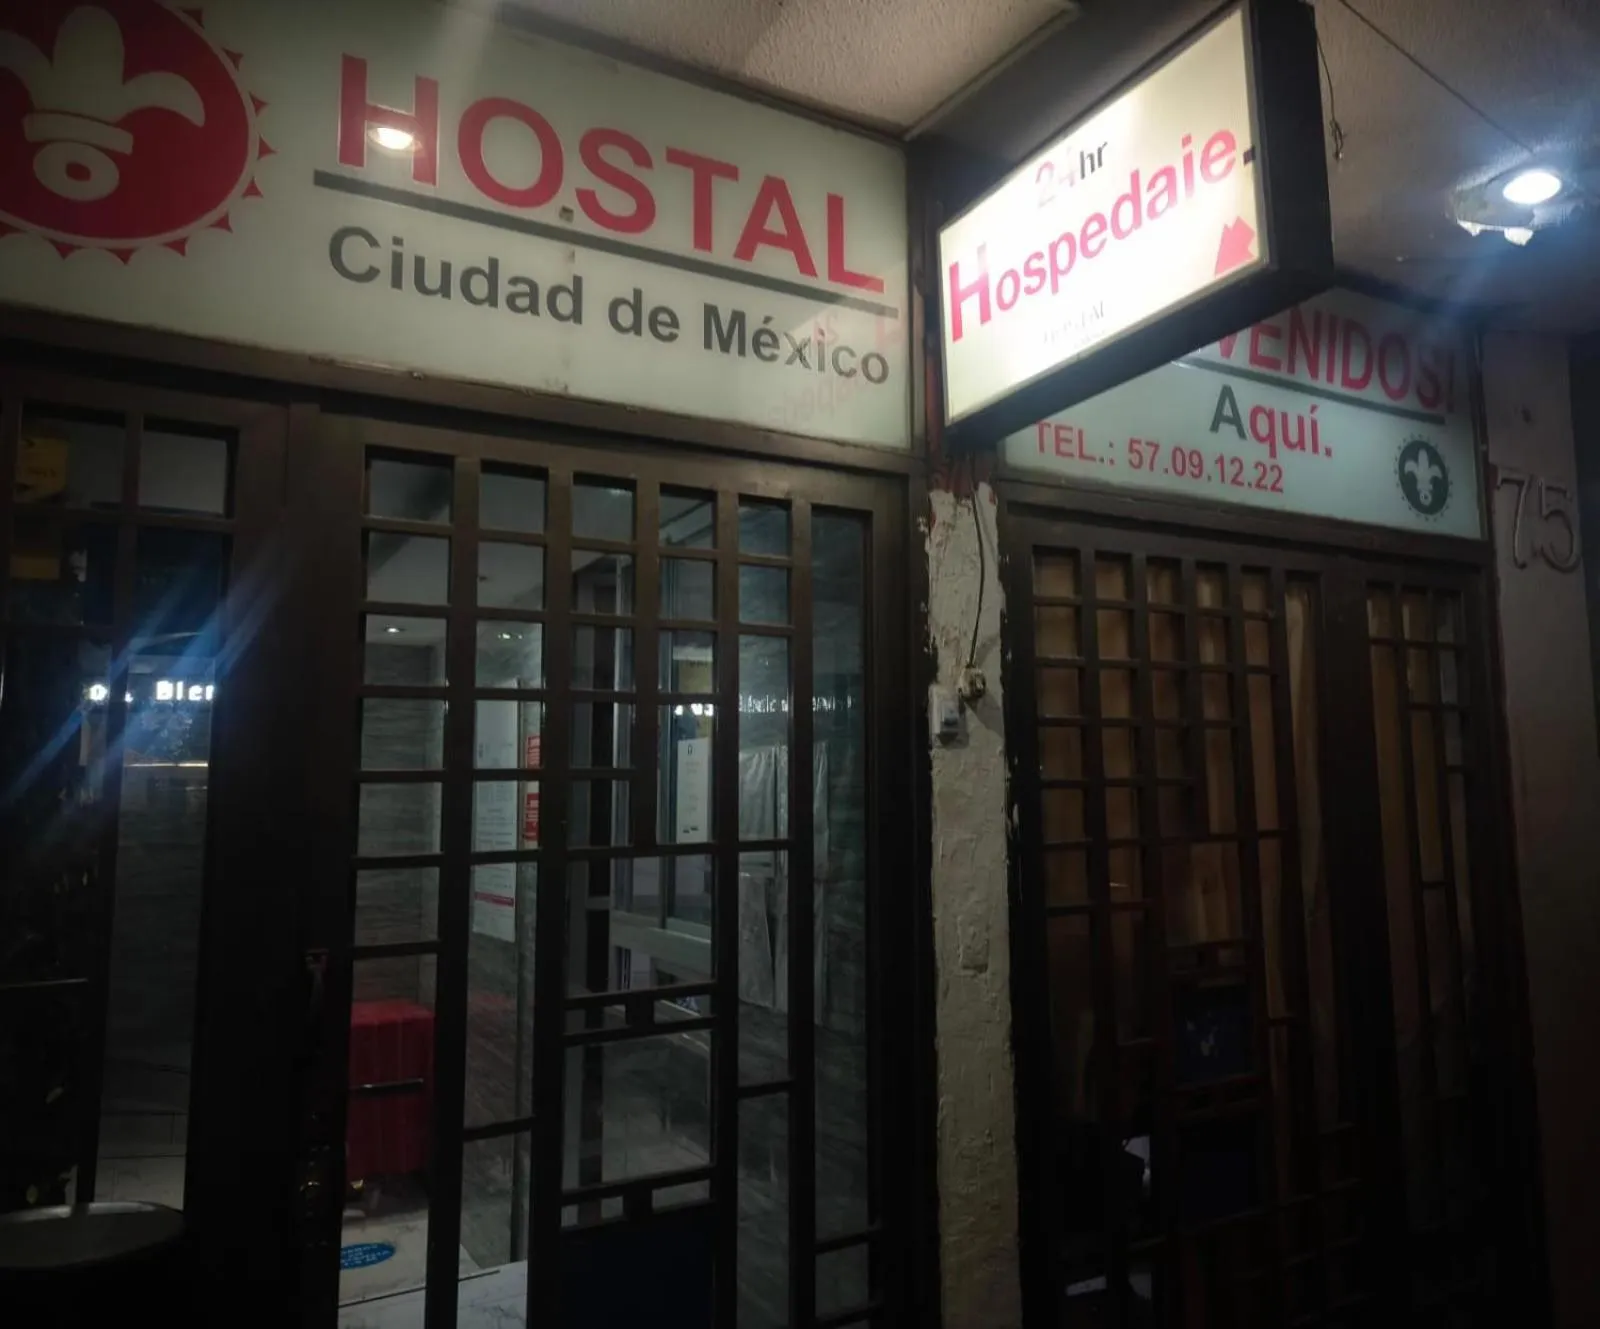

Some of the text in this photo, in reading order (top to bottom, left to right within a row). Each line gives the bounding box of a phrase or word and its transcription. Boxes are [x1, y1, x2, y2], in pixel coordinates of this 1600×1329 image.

[338, 52, 885, 294] HOSTAL
[328, 225, 891, 385] Ciudad de México
[1035, 420, 1285, 494] TEL.: 57.09.12.22
[1208, 384, 1333, 460] Aquí.
[1496, 469, 1581, 574] 75
